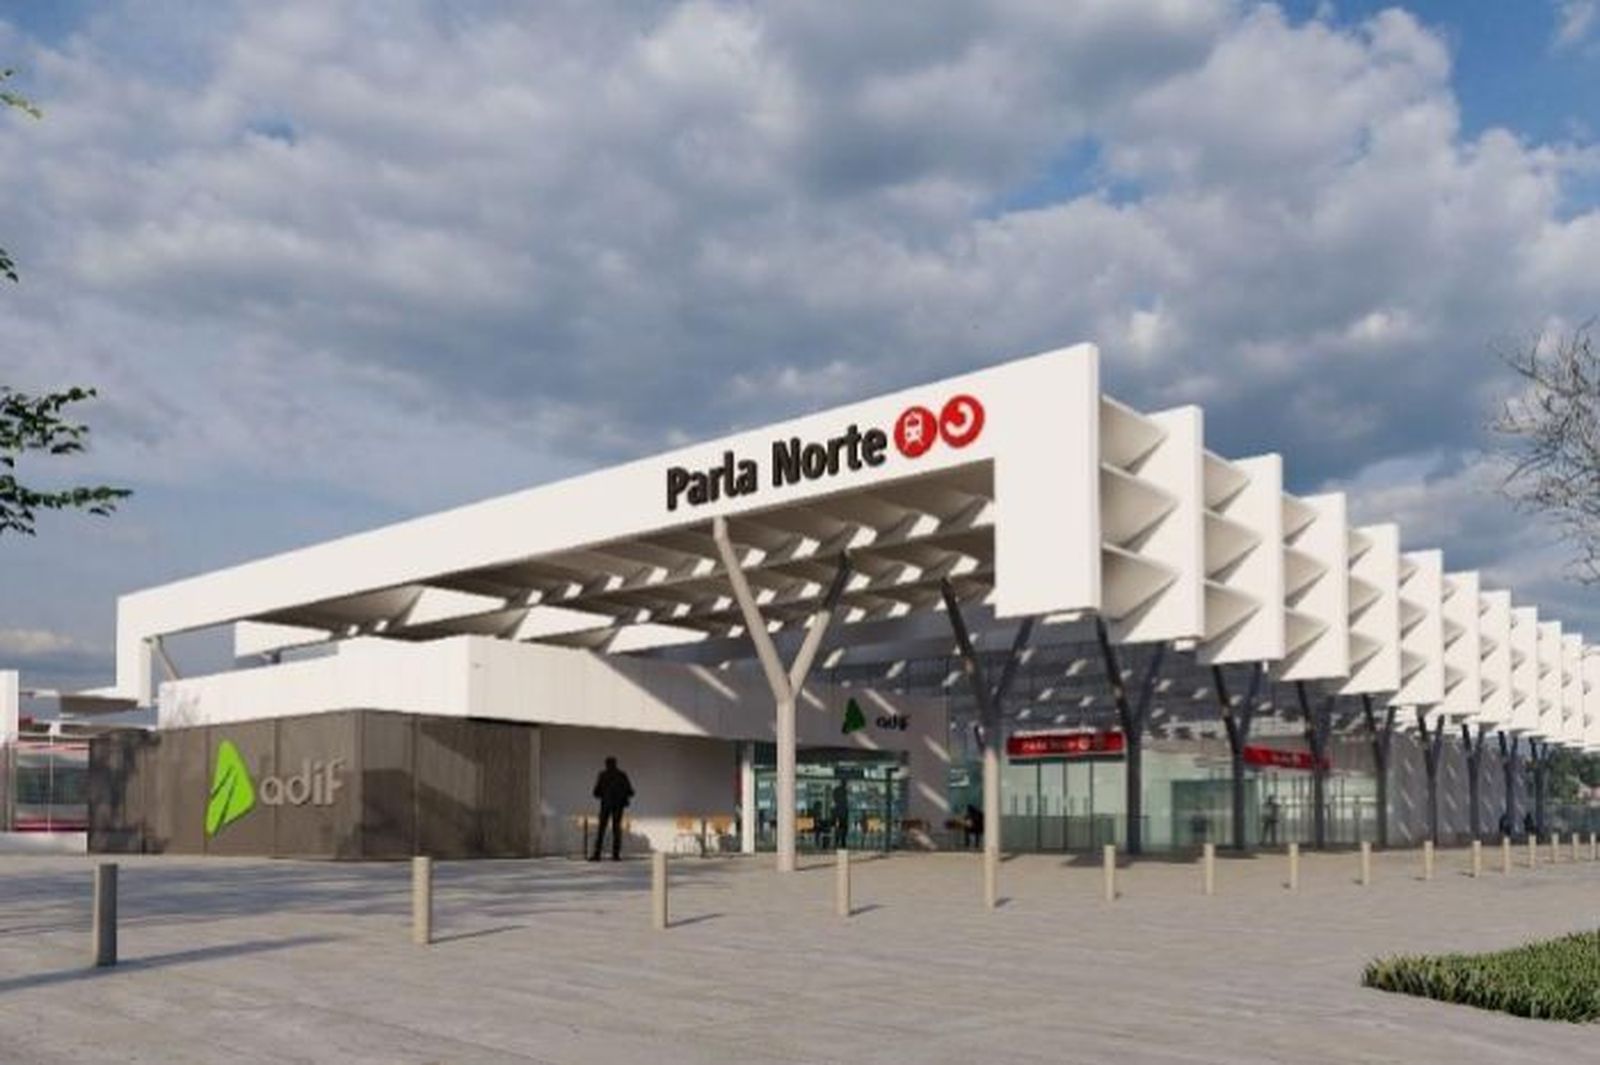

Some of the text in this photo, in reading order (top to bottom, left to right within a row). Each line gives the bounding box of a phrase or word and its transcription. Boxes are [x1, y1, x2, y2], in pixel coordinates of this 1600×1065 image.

[667, 424, 888, 511] Parla Norte
[260, 757, 346, 806] adif
